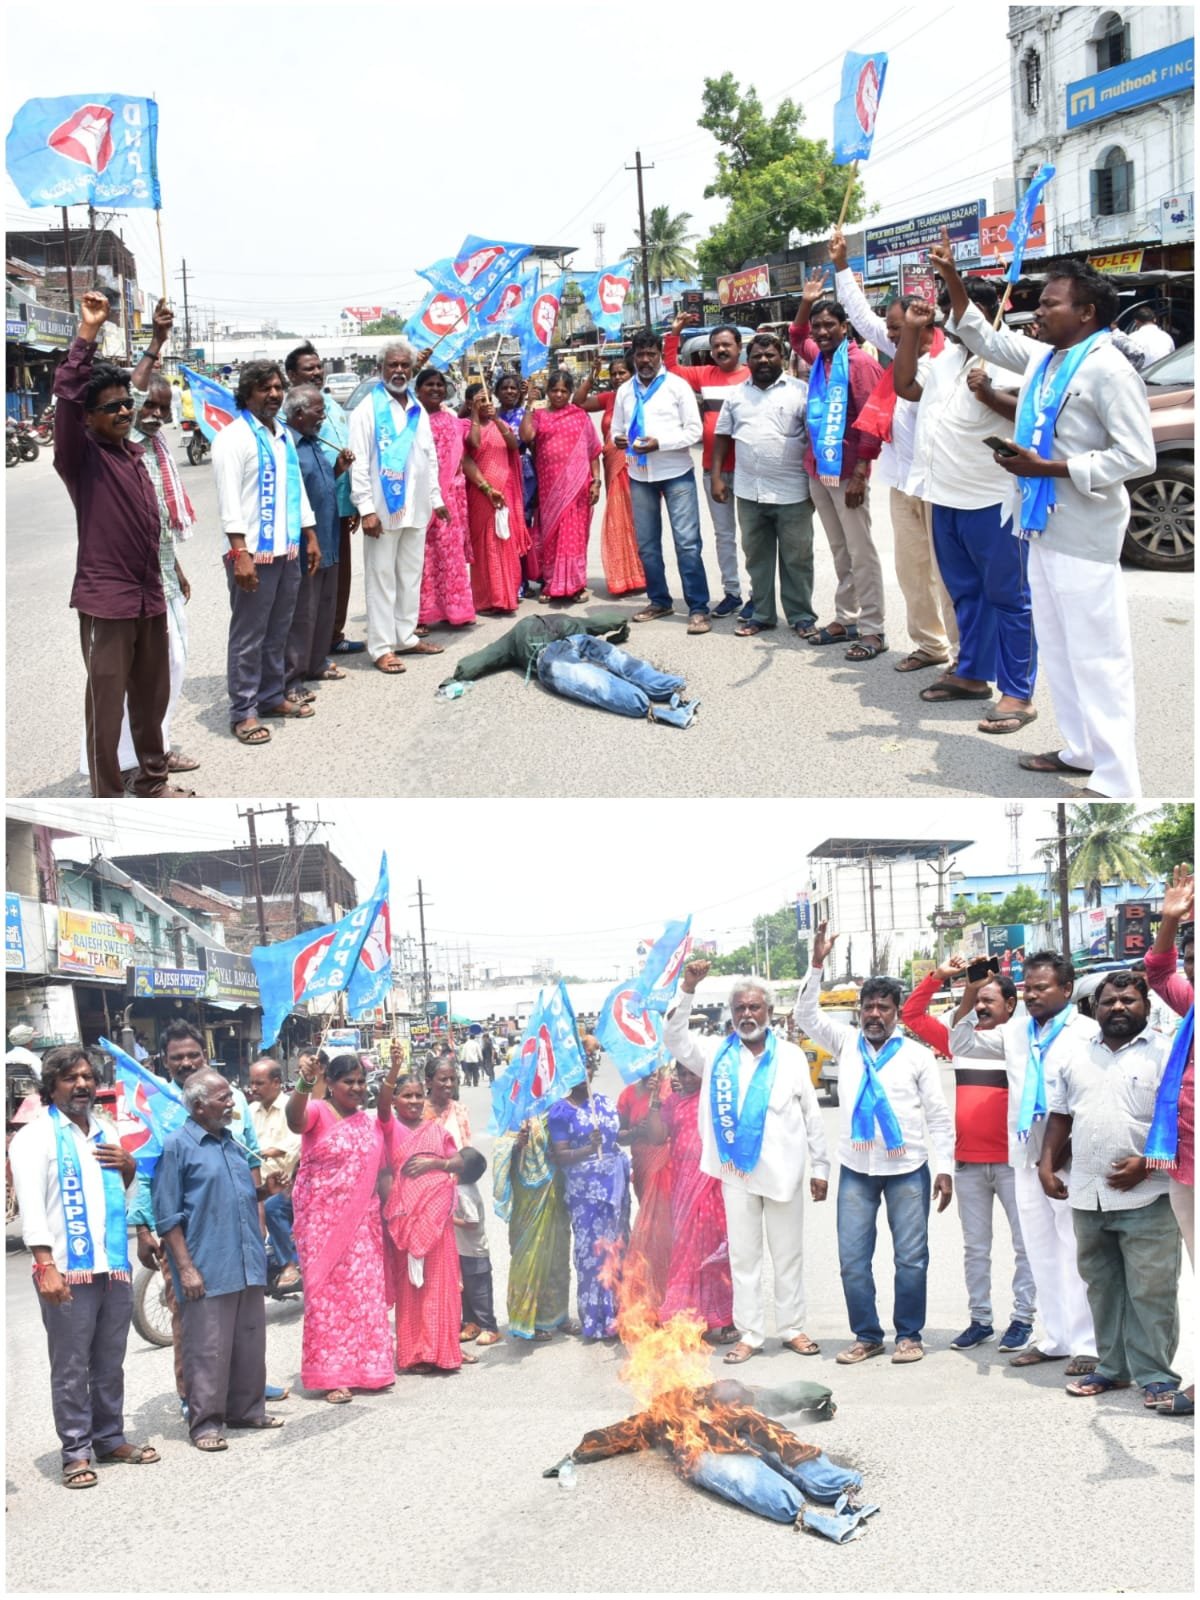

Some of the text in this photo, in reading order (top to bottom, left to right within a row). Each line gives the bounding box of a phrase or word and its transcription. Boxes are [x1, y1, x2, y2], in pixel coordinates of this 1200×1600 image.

[1100, 69, 1158, 102] muthoot
[917, 204, 978, 228] TELANGANA BAZAAR
[1088, 250, 1141, 268] TO-LET
[823, 402, 843, 447] DHPS
[261, 471, 275, 522] DHPS
[73, 933, 103, 952] RAJESH
[90, 921, 117, 938] HOTEL
[154, 972, 206, 989] RAJESH SWEETS
[716, 1078, 735, 1127] DHPS
[63, 1176, 89, 1236] DHPS
